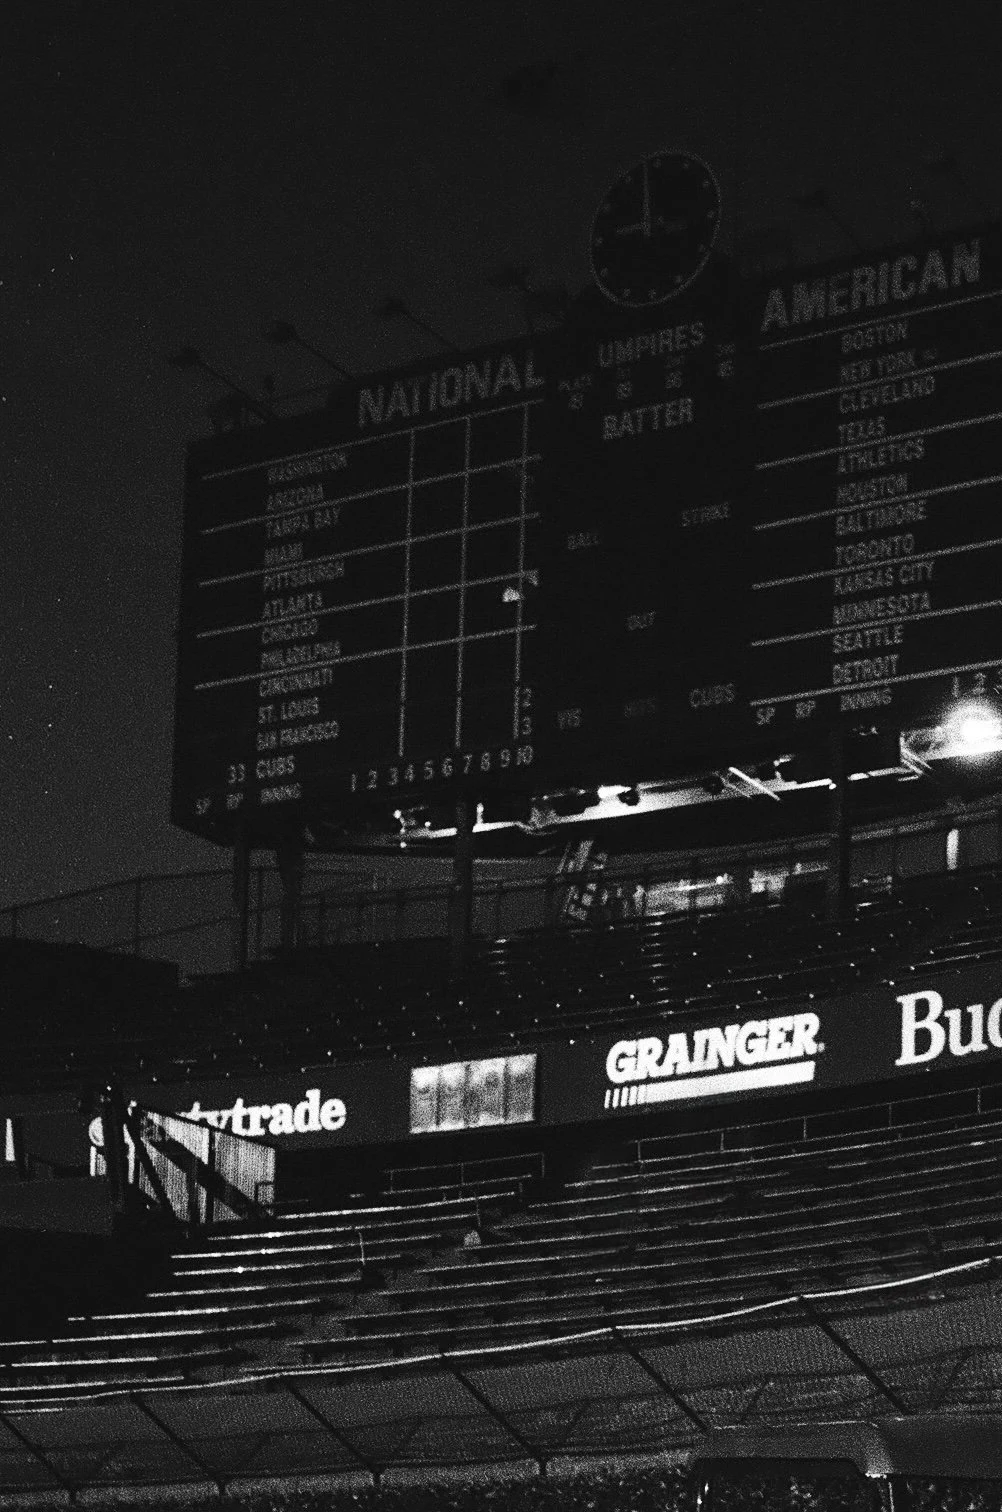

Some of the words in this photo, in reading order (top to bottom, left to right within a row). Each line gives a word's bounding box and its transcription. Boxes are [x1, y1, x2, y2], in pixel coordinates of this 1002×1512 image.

[760, 237, 981, 332] AMERICAN
[599, 321, 706, 368] UMPIRES
[841, 320, 908, 354] BOSTON
[840, 358, 873, 383] NEW
[876, 349, 917, 376] YORK
[357, 352, 546, 429] NATIONAL
[838, 375, 936, 414] CLEVELAND
[602, 397, 693, 440] BATTER
[837, 416, 886, 445] TEXAS
[837, 437, 926, 474] ATHLETICS
[836, 473, 908, 504] HOUSTON
[266, 513, 310, 539] TAMPA
[314, 506, 341, 530] BAY
[835, 500, 927, 536] BALTIMORE
[835, 533, 915, 566] TORONTO
[263, 560, 345, 592] PITTSBURGH
[834, 567, 894, 595] KANSAS
[900, 561, 935, 585] CITY
[262, 590, 323, 620] ATLANTA
[833, 591, 931, 625] MINNESOTA
[833, 625, 904, 654] SEATTLE
[832, 654, 900, 685] DETROIT
[952, 676, 960, 697] 1
[972, 672, 987, 694] 2
[281, 696, 320, 720] LOUIS
[522, 687, 532, 707] 2
[689, 683, 735, 709] CUBS
[840, 687, 892, 712] INNING
[521, 716, 532, 736] 3
[756, 707, 775, 725] SP
[257, 731, 277, 751] SAN
[280, 720, 339, 747] FRANCISCO
[228, 763, 246, 784] 33
[256, 754, 295, 779] CUBS
[351, 773, 357, 792] 1
[367, 770, 378, 789] 2
[388, 767, 399, 786] 3
[404, 764, 415, 782] 4
[424, 760, 434, 780] 5
[441, 757, 453, 777] 6
[463, 754, 473, 774] 7
[480, 752, 491, 771] 8
[500, 749, 511, 768] 9
[516, 745, 533, 766] 10
[605, 1012, 821, 1084] GRAINGER
